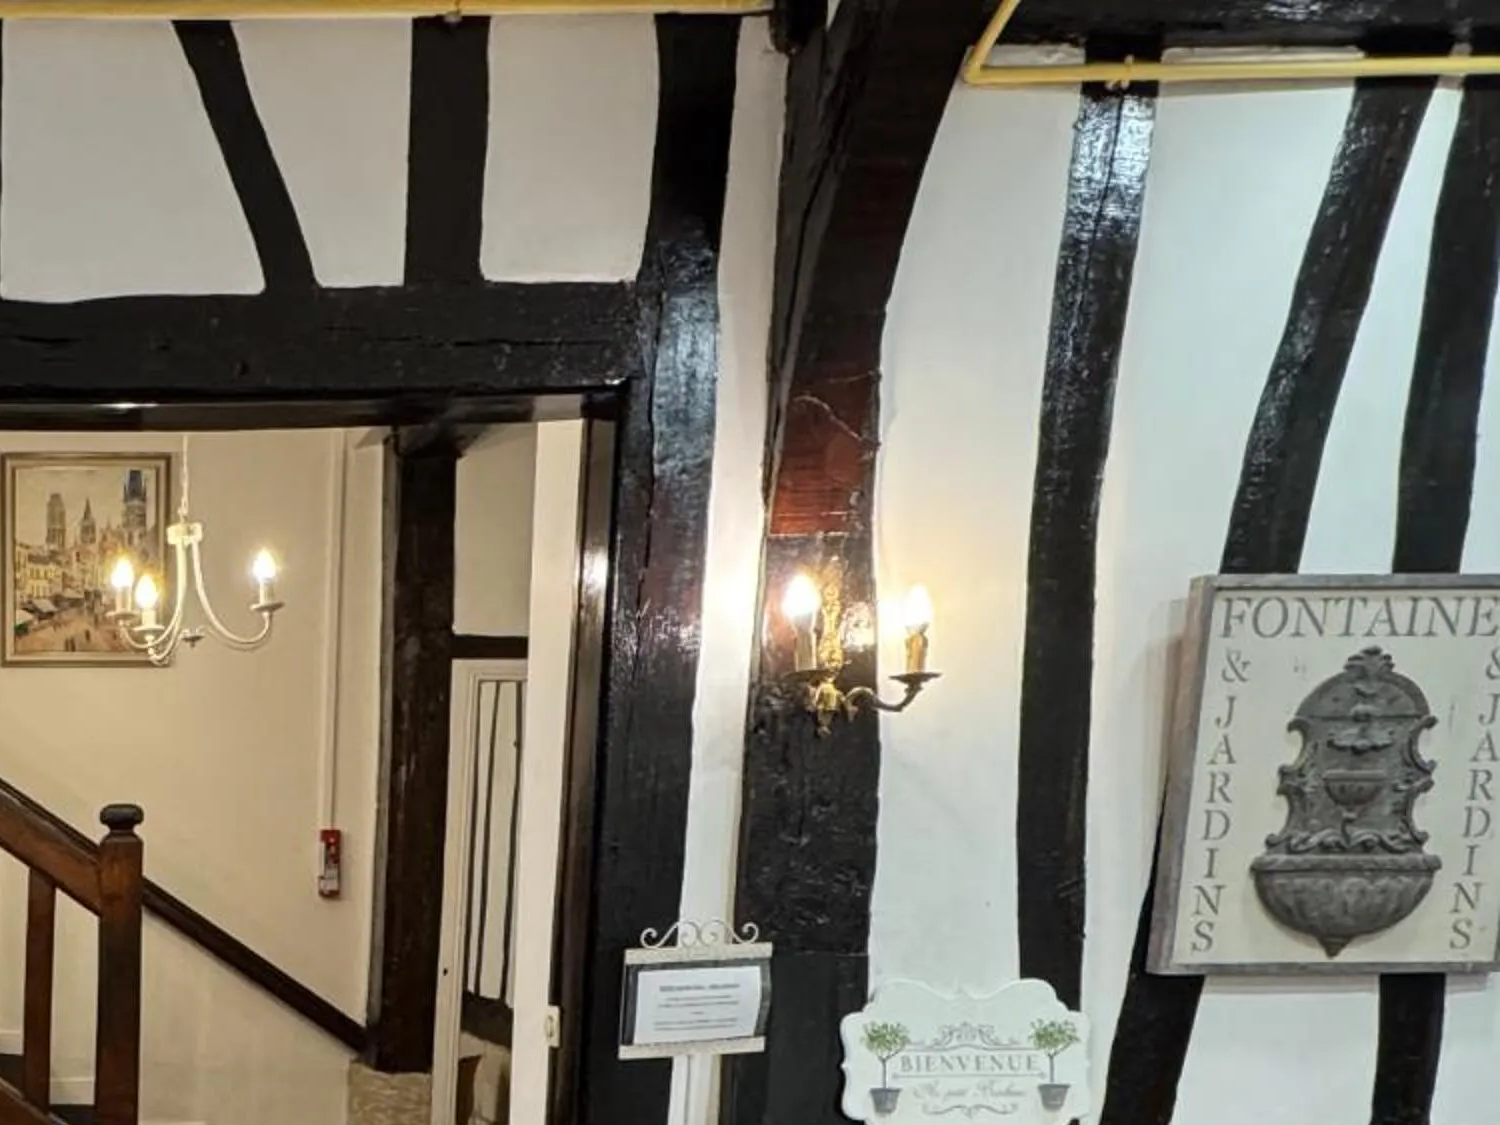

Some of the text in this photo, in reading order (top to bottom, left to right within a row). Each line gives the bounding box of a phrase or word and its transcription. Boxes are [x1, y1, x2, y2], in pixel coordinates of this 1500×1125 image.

[1220, 596, 1500, 639] FONTAINE
[1190, 647, 1251, 953] & JARDINS
[1449, 693, 1500, 951] JARDINS
[900, 1054, 1041, 1073] BIENVENUE
